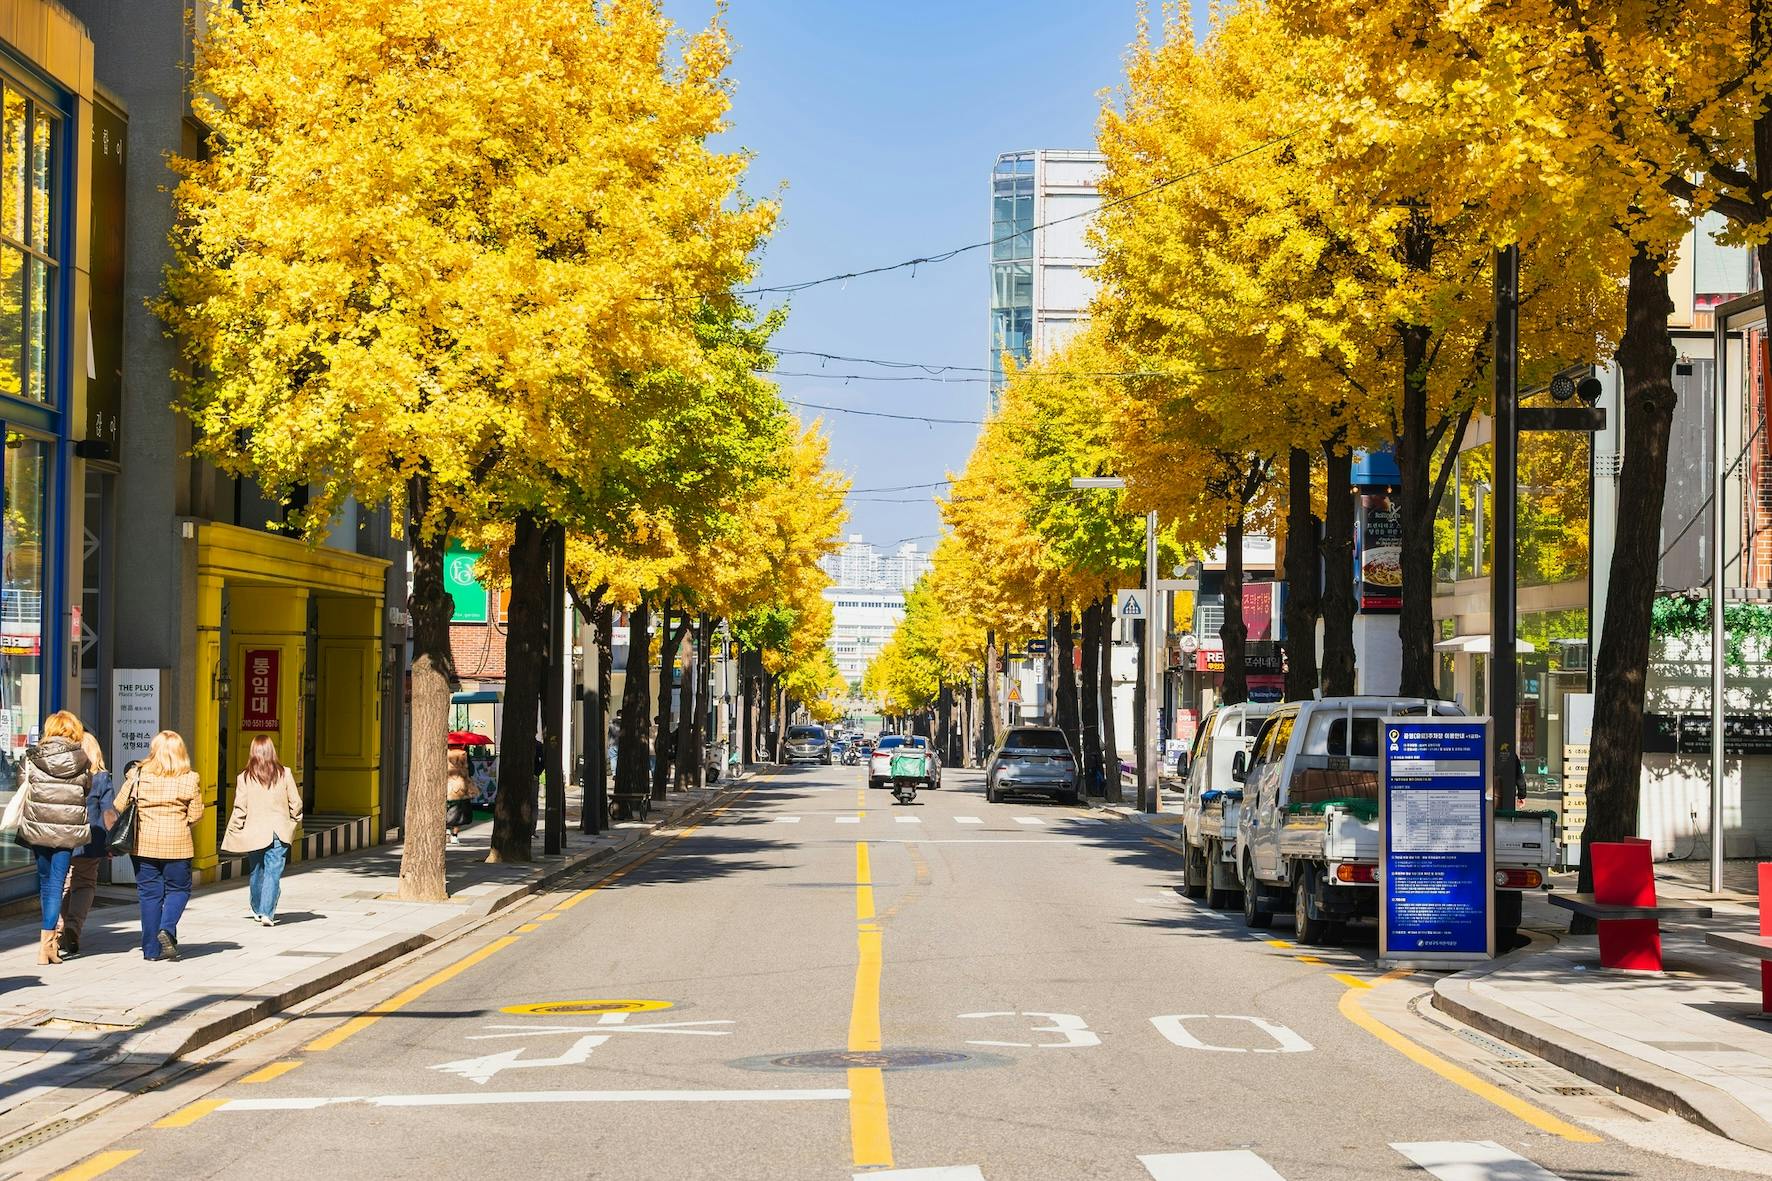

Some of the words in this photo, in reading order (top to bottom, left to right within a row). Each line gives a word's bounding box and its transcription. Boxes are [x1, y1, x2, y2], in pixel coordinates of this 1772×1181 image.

[252, 657, 270, 714] 통임대
[121, 732, 151, 741] 더플러스
[122, 742, 150, 750] 성형외과
